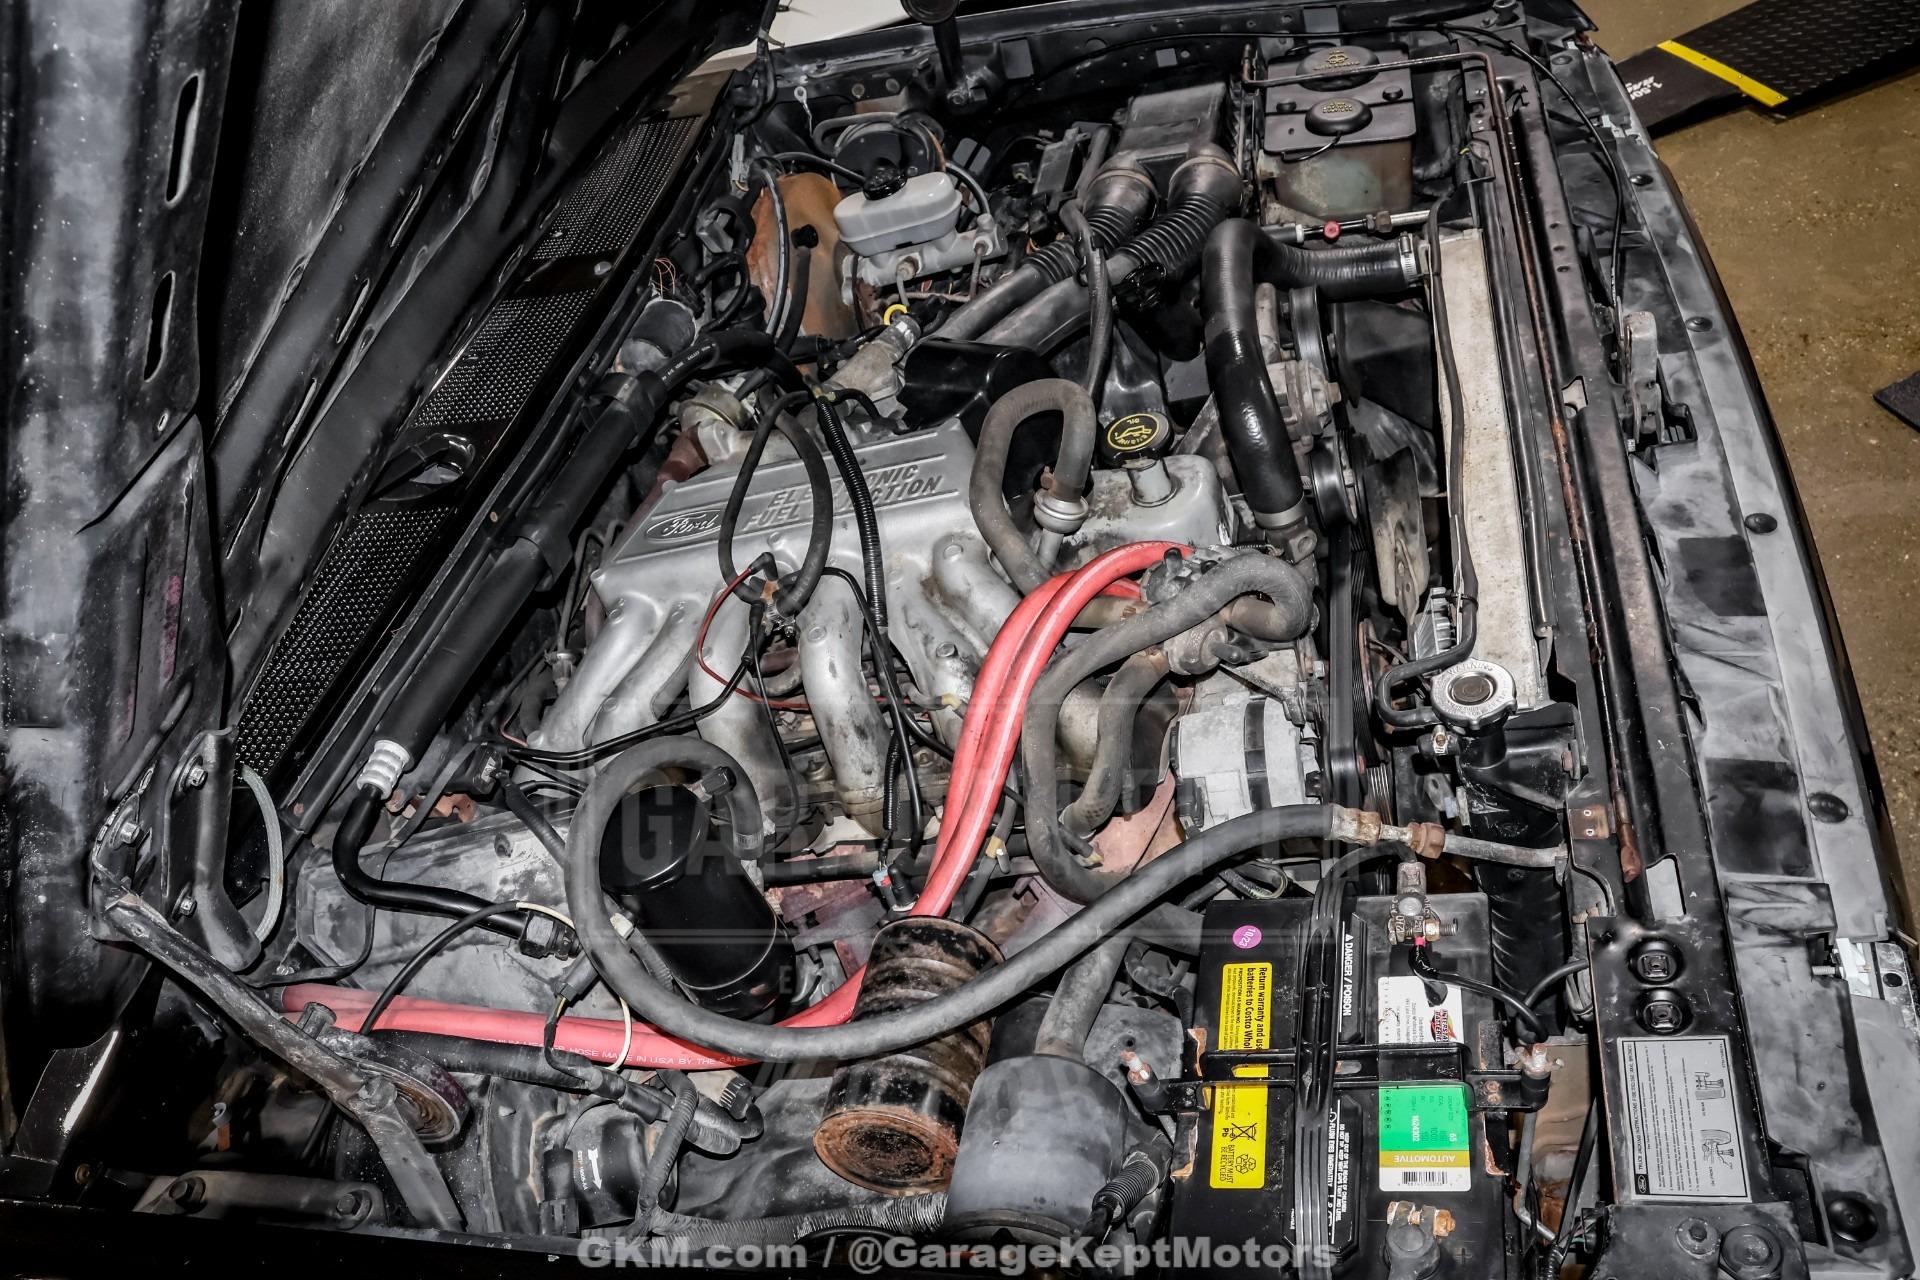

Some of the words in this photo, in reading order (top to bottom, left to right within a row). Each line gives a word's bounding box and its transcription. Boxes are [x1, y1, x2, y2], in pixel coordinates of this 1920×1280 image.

[660, 512, 717, 537] Ford
[1343, 942, 1354, 976] DANGER
[1246, 967, 1256, 998] batteries
[1258, 967, 1268, 990] Return
[1245, 998, 1254, 1006] to
[1255, 991, 1266, 1022] warranty
[1342, 984, 1352, 1016] POISON
[1244, 1006, 1254, 1029] Costco
[1243, 1029, 1253, 1049] Whol
[1256, 1023, 1266, 1037] and
[601, 1050, 633, 1062] MAE
[678, 1057, 692, 1065] BY
[696, 1057, 716, 1065] THE
[1221, 1127, 1229, 1138] Pb
[1328, 1123, 1336, 1139] FLUSH
[1226, 1144, 1235, 1168] BATTERY
[1392, 1154, 1456, 1163] AUTOMOTIVE
[1219, 1154, 1228, 1182] RECYCLED
[1226, 1168, 1234, 1184] MUST
